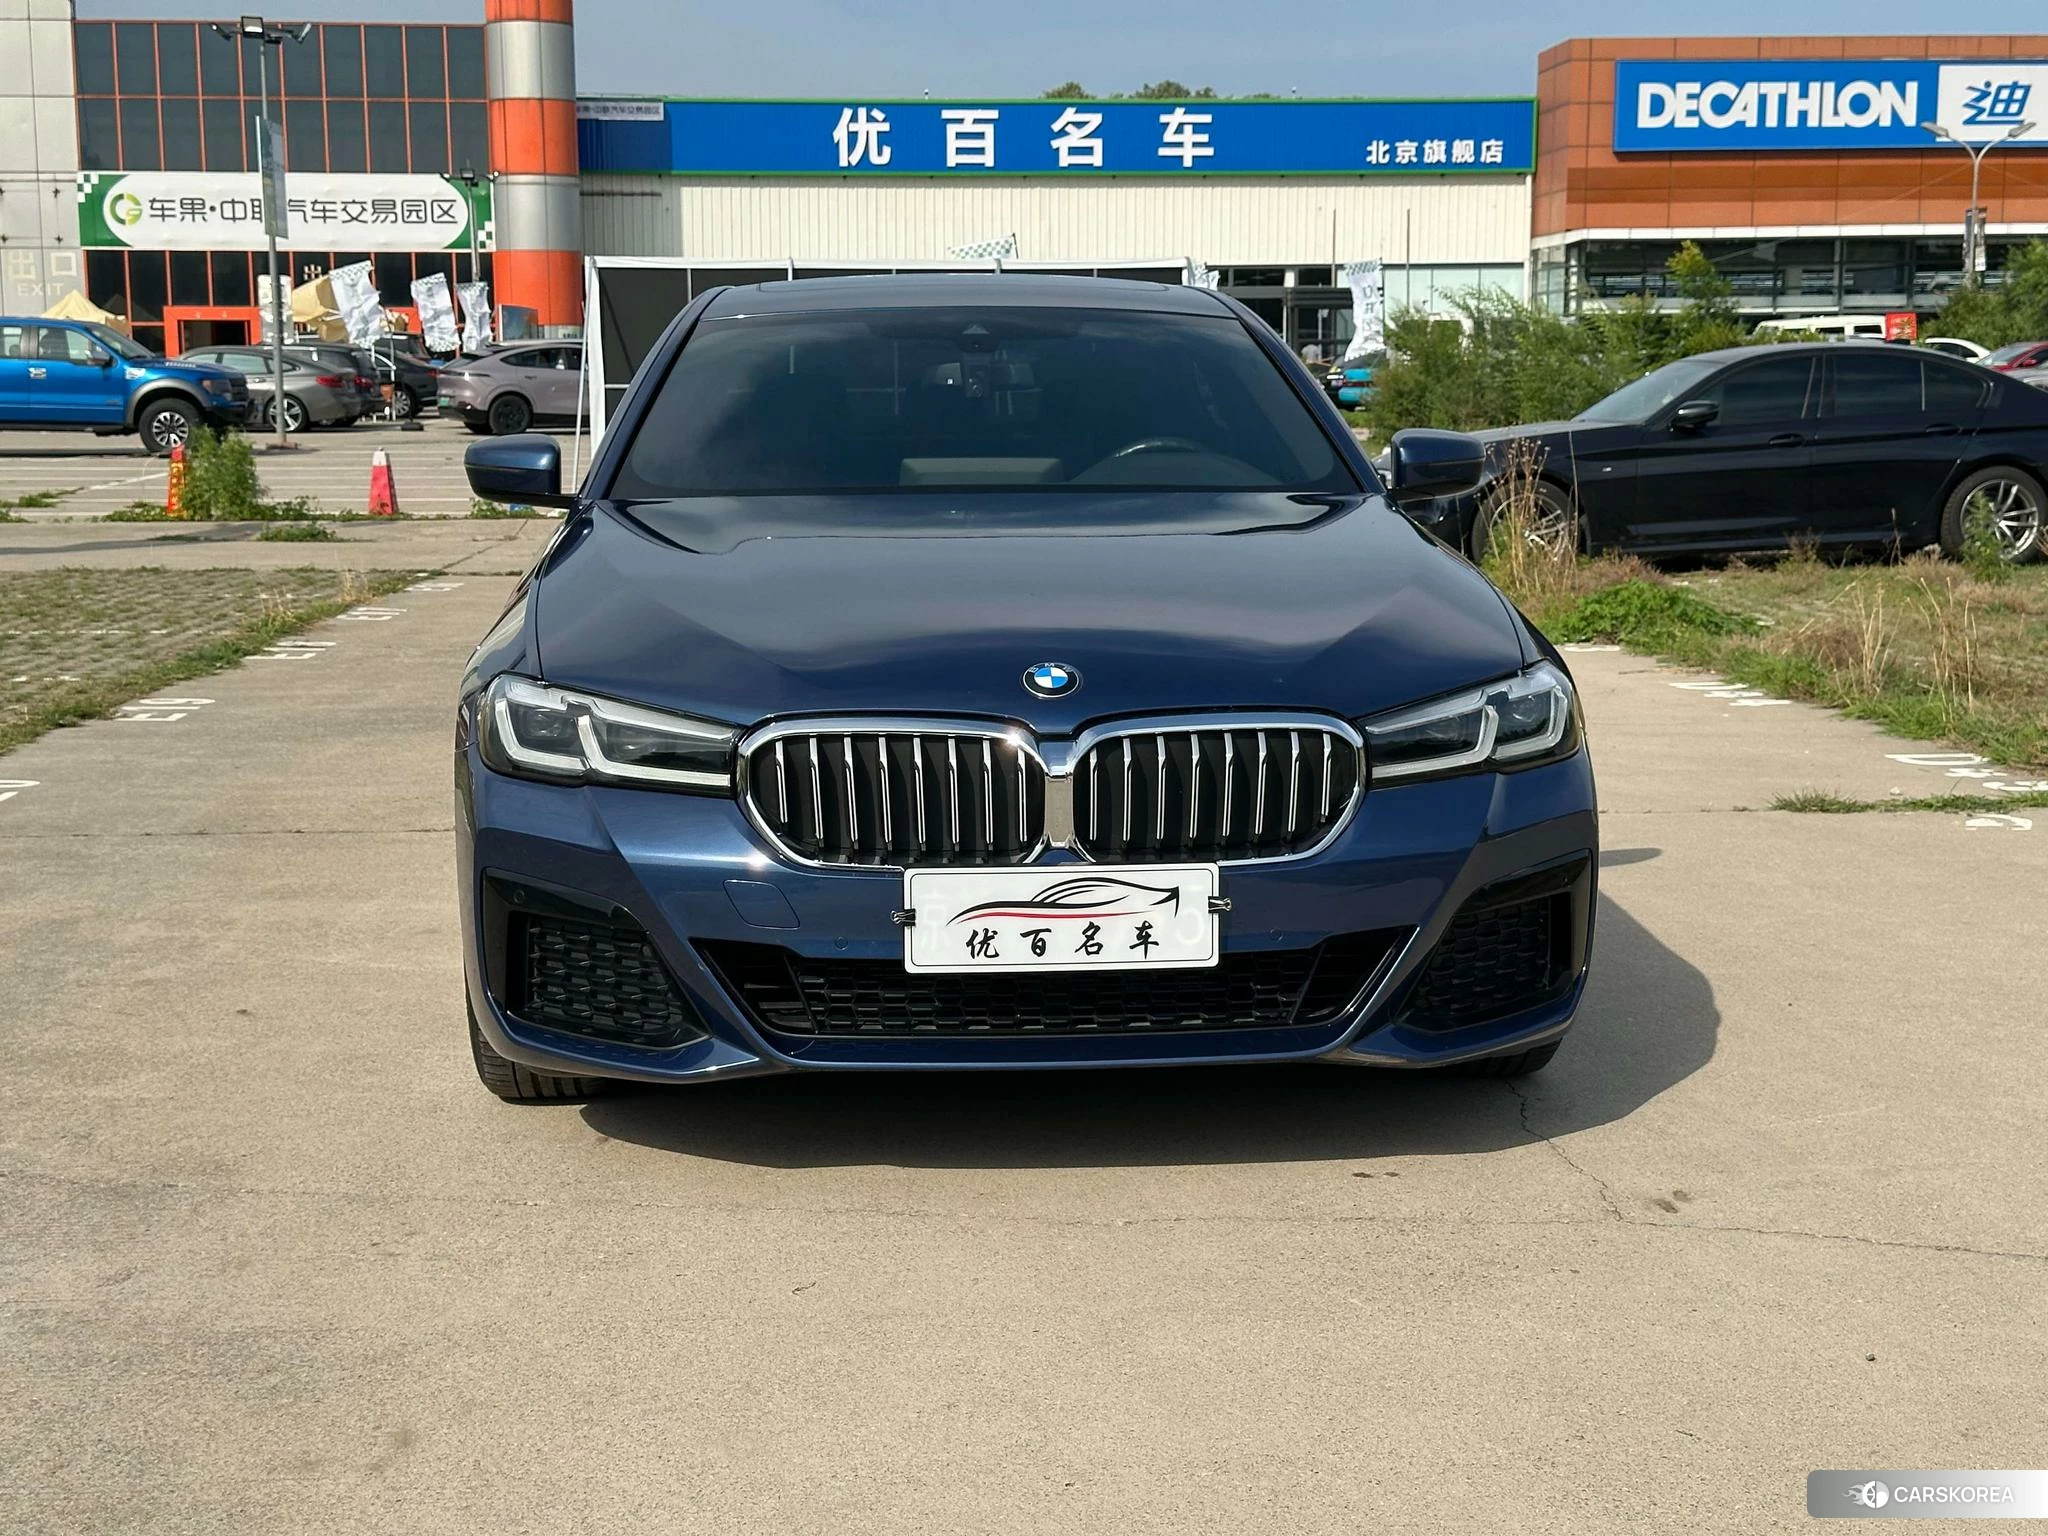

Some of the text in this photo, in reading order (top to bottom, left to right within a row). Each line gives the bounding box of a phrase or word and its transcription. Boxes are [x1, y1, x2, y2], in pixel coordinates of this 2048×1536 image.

[1637, 80, 1918, 128] DECATHLON
[1962, 80, 2032, 125] 迪
[832, 107, 1214, 167] 优百名车
[1366, 139, 1503, 164] 北京旗舰店
[17, 283, 64, 296] EXIT
[115, 697, 216, 722] E19
[965, 920, 1160, 960] 优百名车
